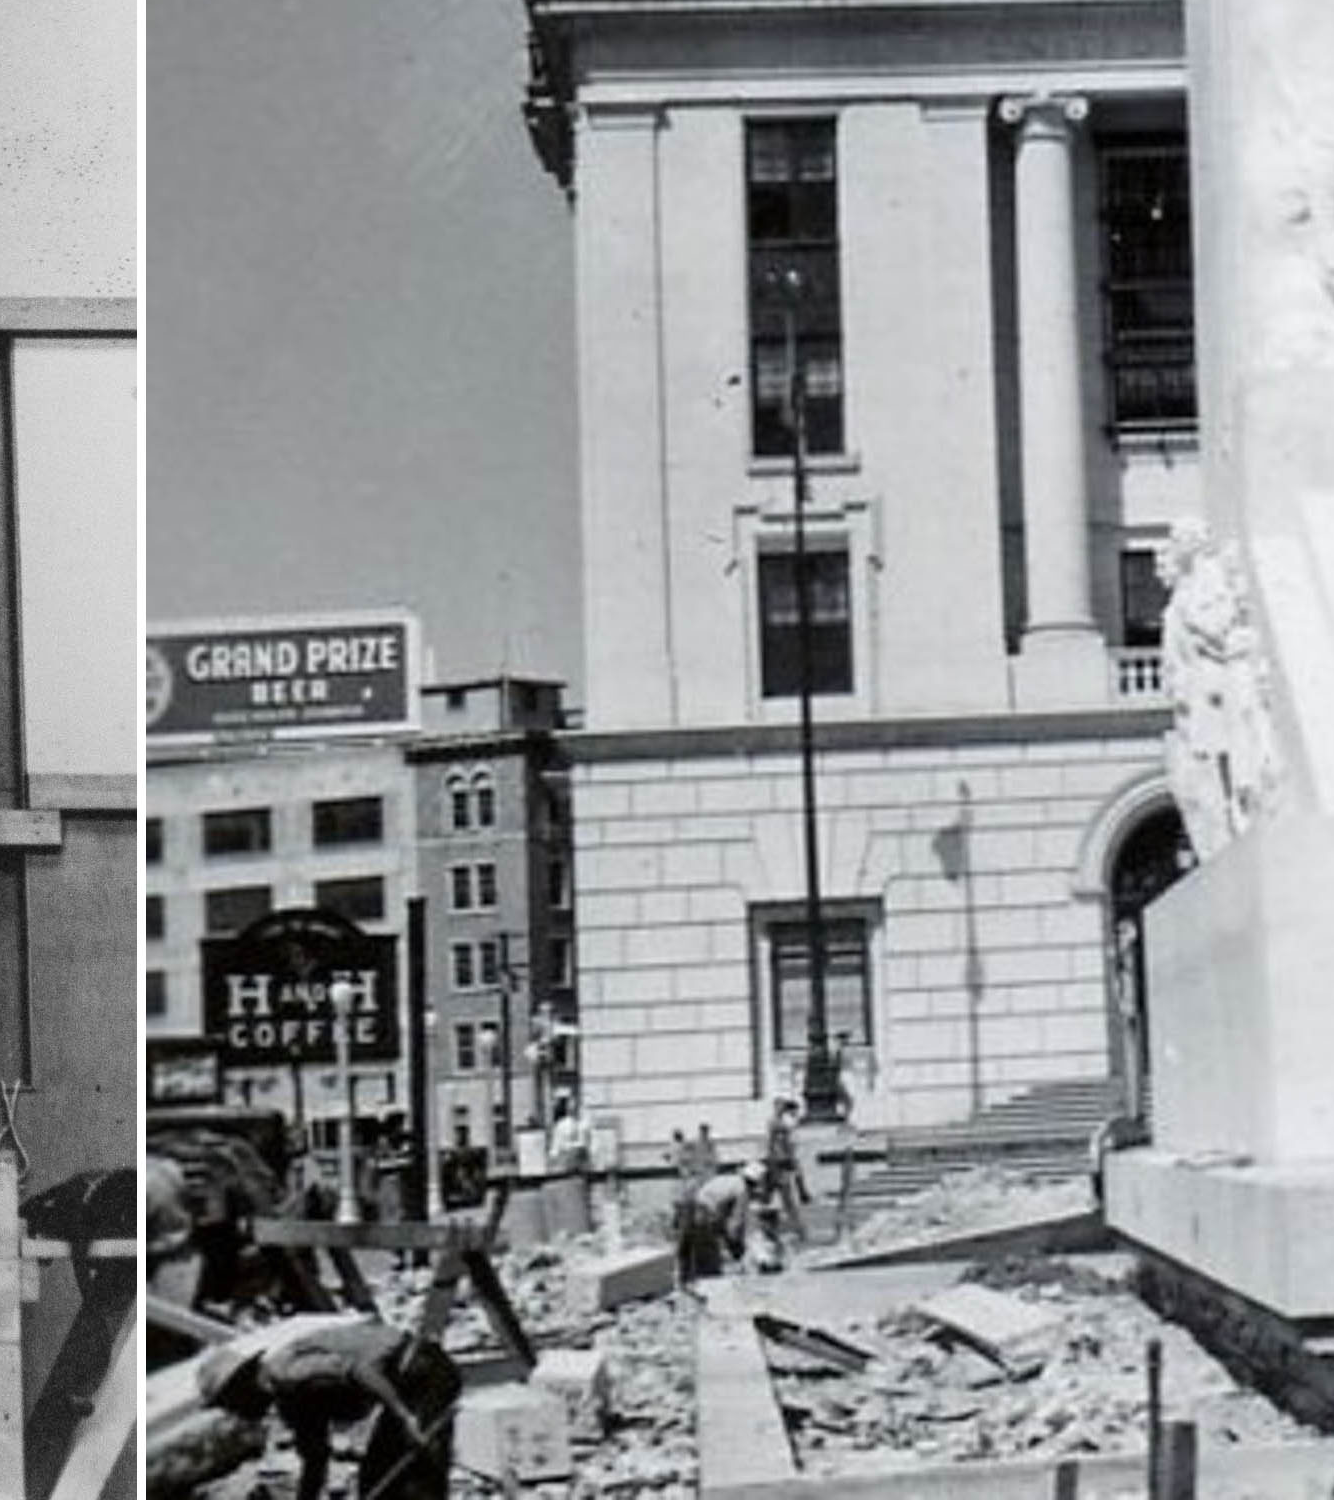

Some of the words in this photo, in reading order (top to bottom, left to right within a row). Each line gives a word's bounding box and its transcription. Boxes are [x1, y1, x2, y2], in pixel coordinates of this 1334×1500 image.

[187, 641, 298, 680] GRAND
[307, 637, 397, 674] PRIZE
[252, 680, 328, 703] BEER
[227, 975, 272, 1016] H
